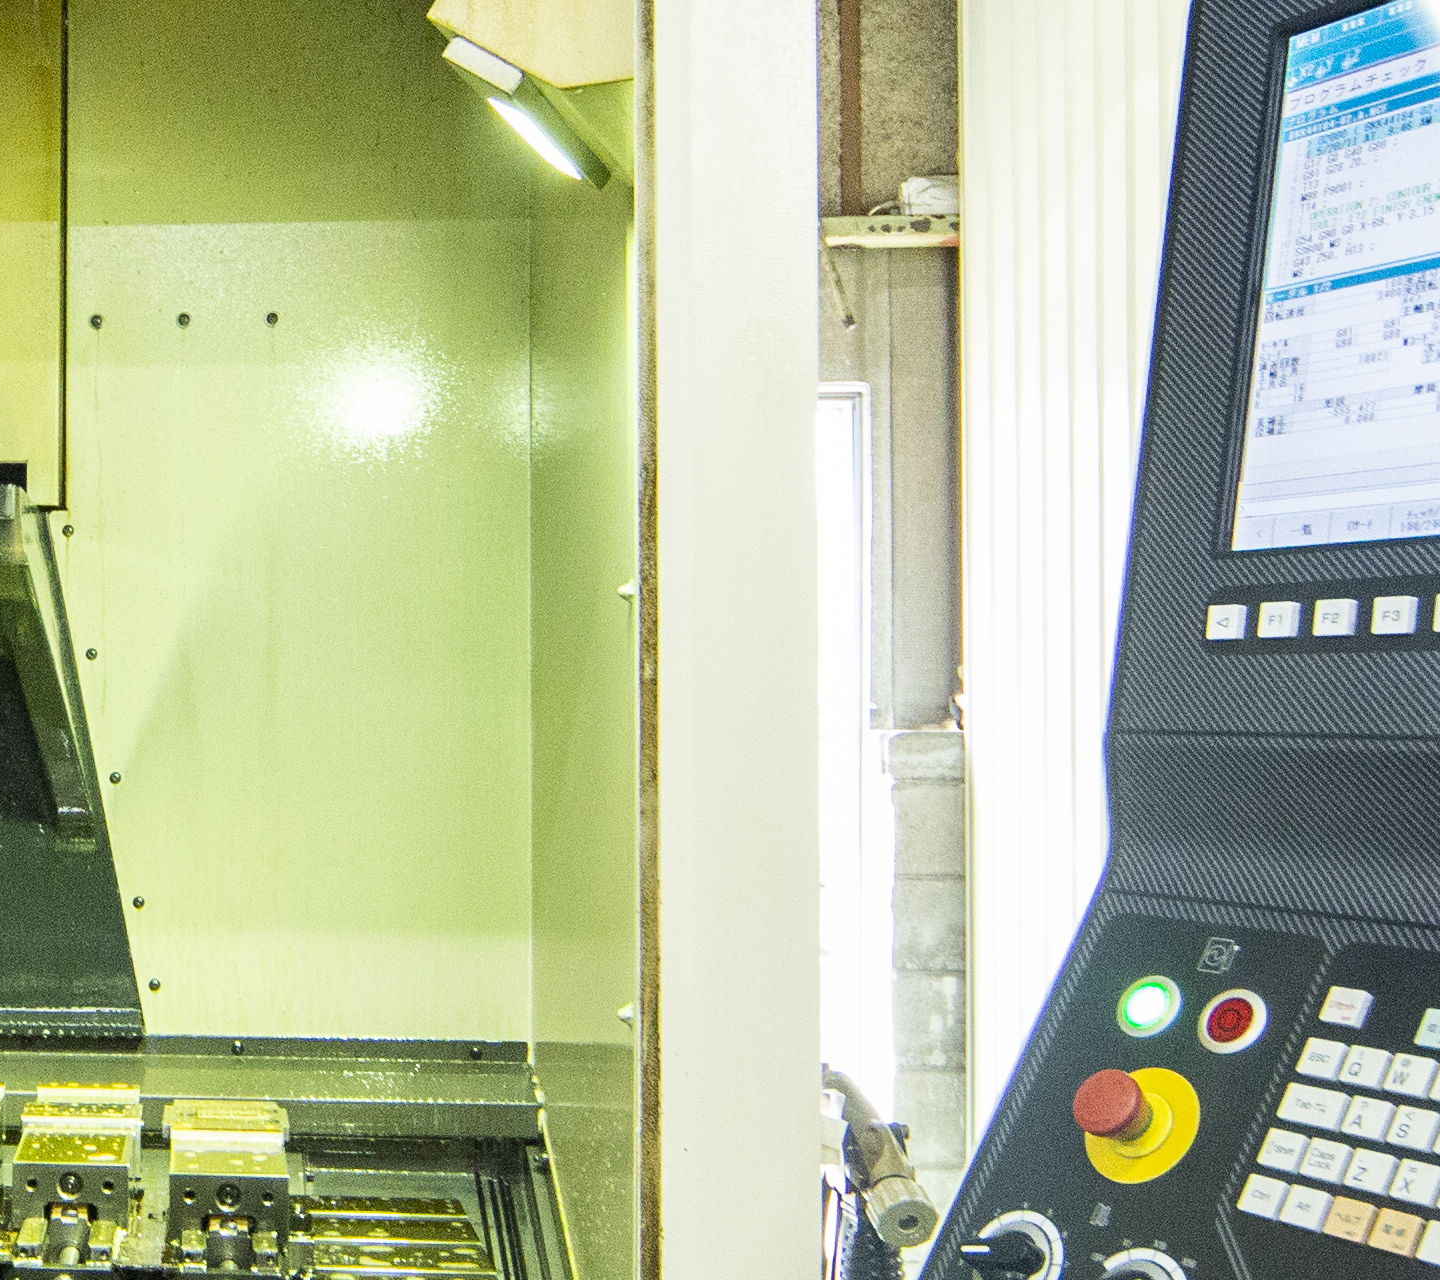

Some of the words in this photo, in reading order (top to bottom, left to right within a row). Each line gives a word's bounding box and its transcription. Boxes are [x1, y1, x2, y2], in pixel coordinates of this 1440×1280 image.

[1268, 613, 1285, 626] F1
[1321, 610, 1341, 625] F2
[1381, 608, 1403, 623] F3
[1346, 1060, 1363, 1077] Q
[1390, 1070, 1410, 1086] W
[1349, 1112, 1365, 1128] A
[1394, 1122, 1411, 1140] S
[1351, 1165, 1367, 1182] Z
[1397, 1177, 1414, 1194] X
